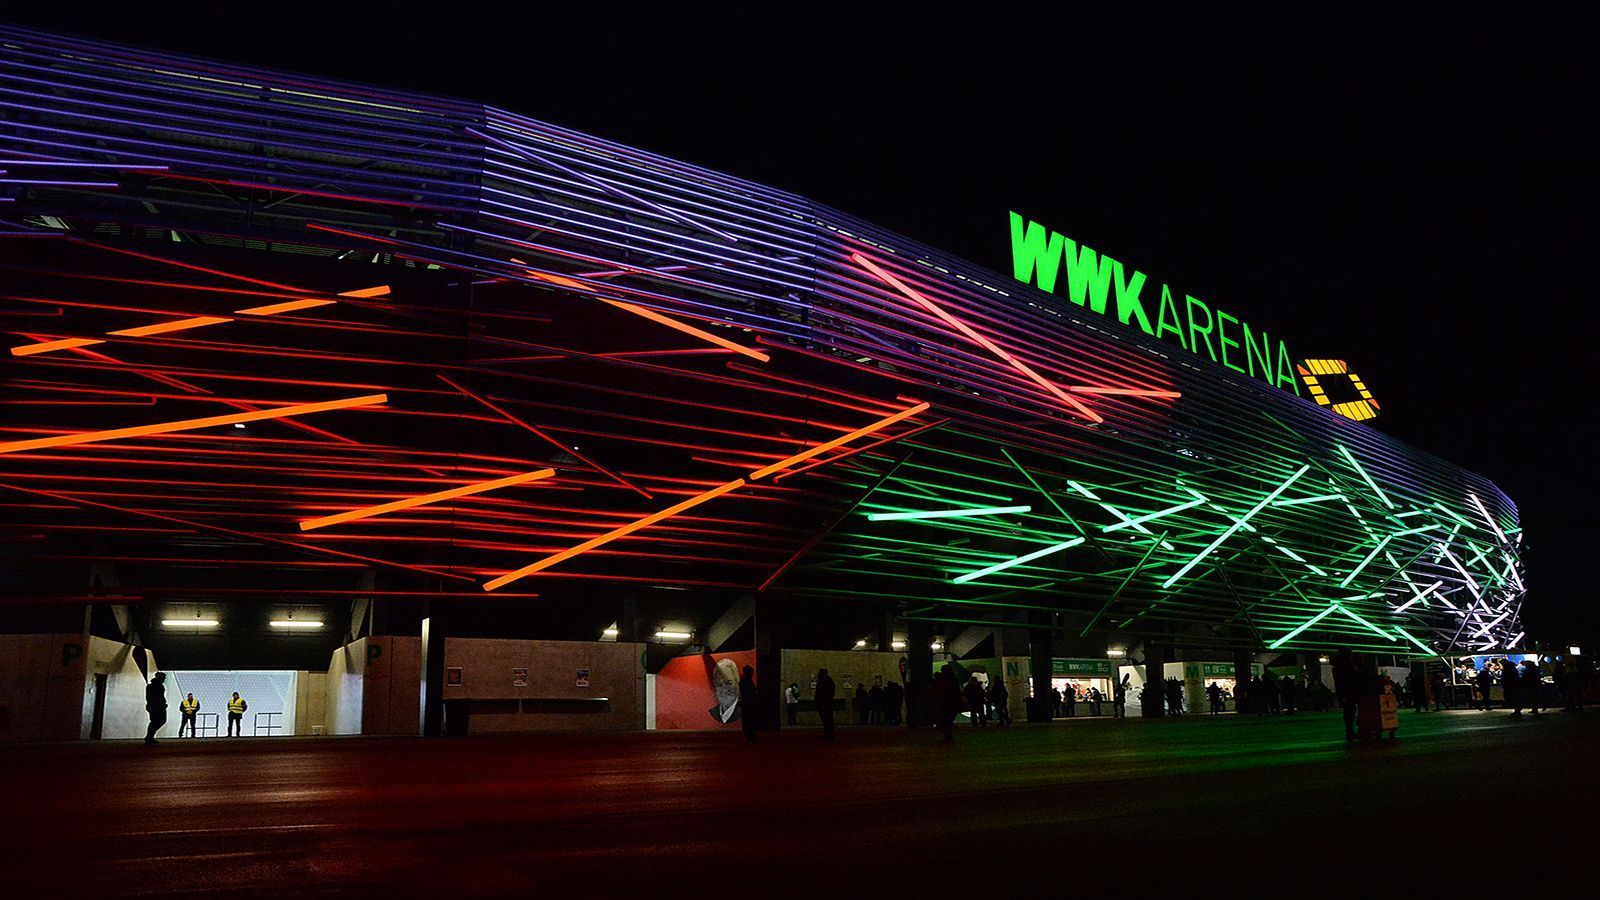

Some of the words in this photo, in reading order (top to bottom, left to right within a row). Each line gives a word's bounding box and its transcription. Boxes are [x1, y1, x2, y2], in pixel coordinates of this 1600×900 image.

[63, 643, 82, 666] P
[367, 645, 381, 666] P
[1007, 662, 1019, 676] N
